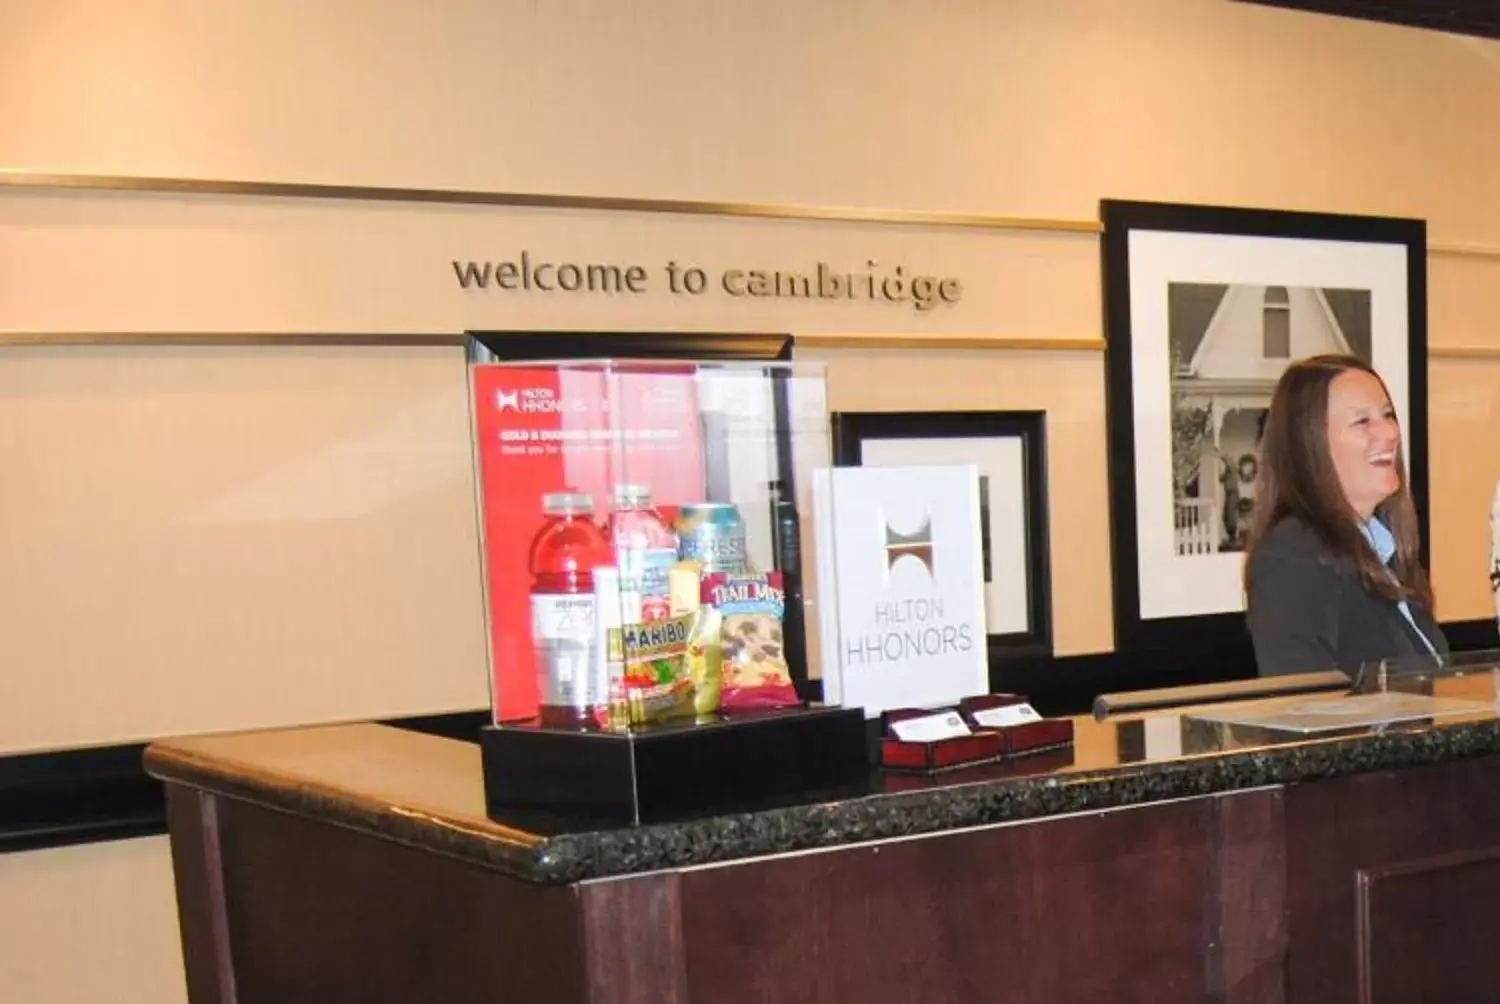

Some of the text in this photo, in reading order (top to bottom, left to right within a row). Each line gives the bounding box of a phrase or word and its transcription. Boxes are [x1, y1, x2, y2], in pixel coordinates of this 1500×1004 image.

[452, 250, 961, 311] welcome to cambridge
[523, 399, 588, 413] HHON
[711, 582, 786, 608] TRAIL MIX
[875, 596, 944, 625] HILTON
[625, 621, 686, 649] HARIBO
[847, 623, 973, 666] HHONORS
